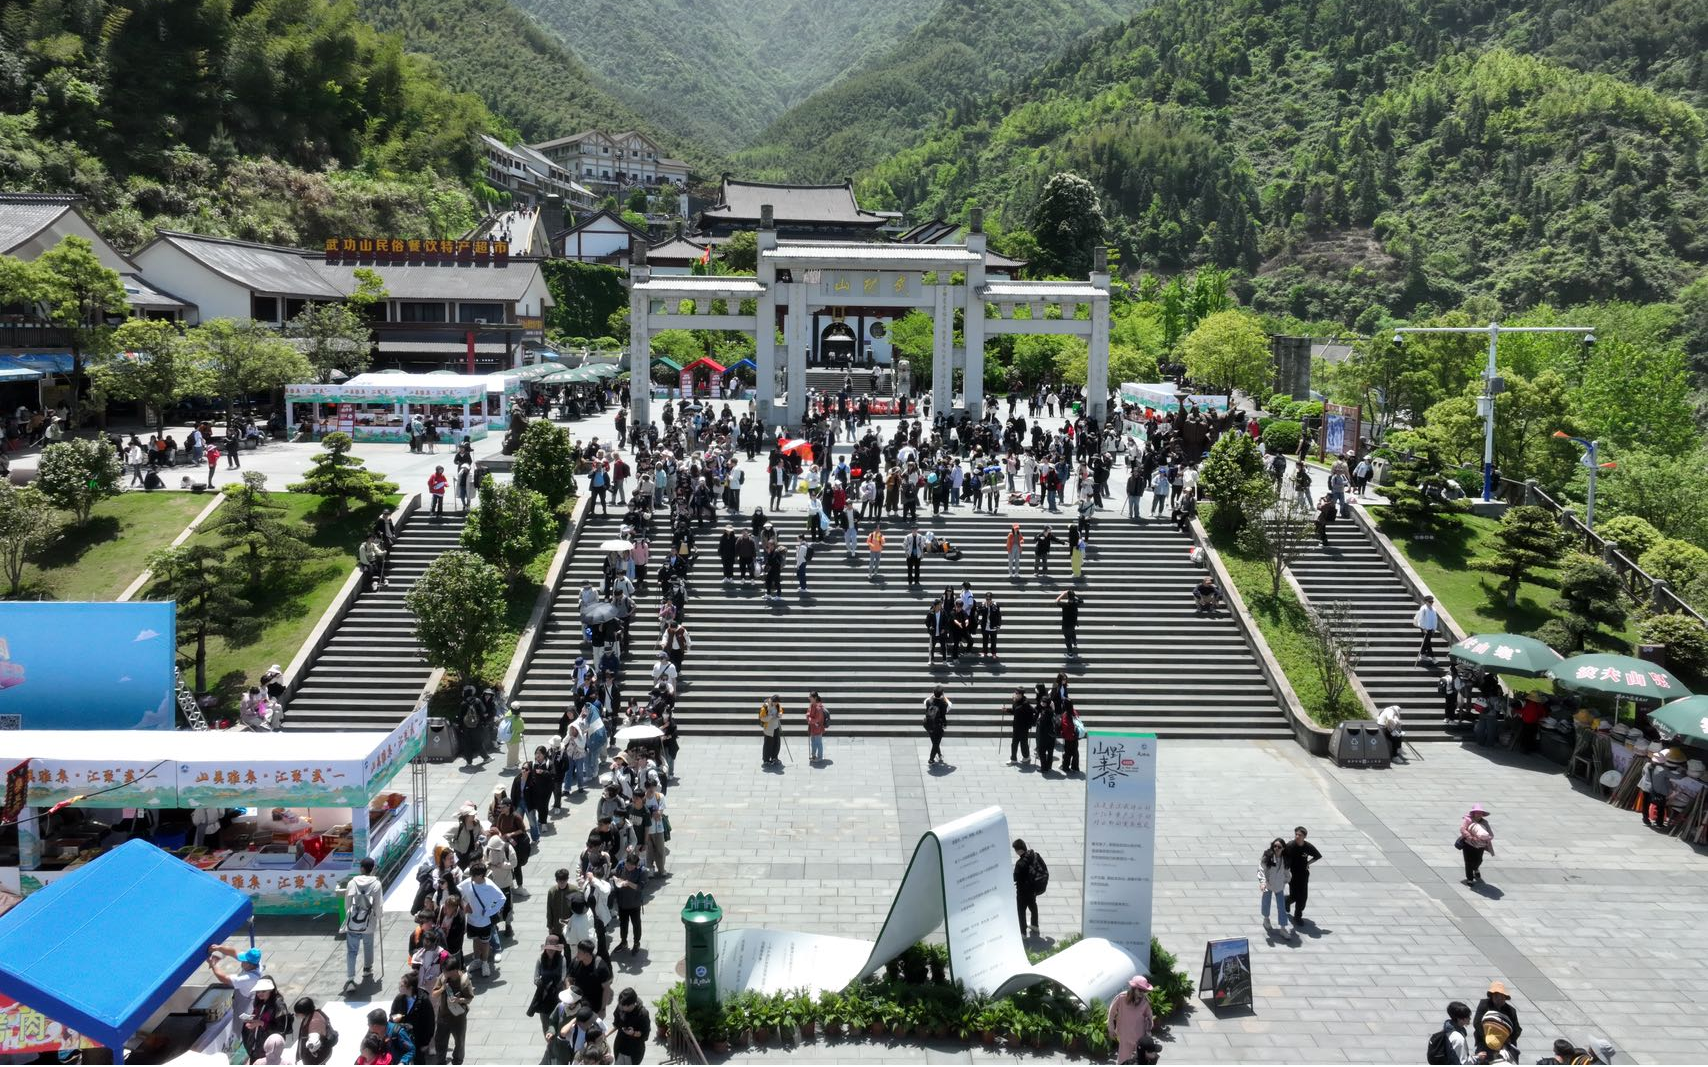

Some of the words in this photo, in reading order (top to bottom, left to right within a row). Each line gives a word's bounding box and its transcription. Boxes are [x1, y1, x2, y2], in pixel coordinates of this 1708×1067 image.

[325, 238, 508, 254] 武功山民俗餐饮特产超市
[1575, 665, 1671, 689] 农夫山泉
